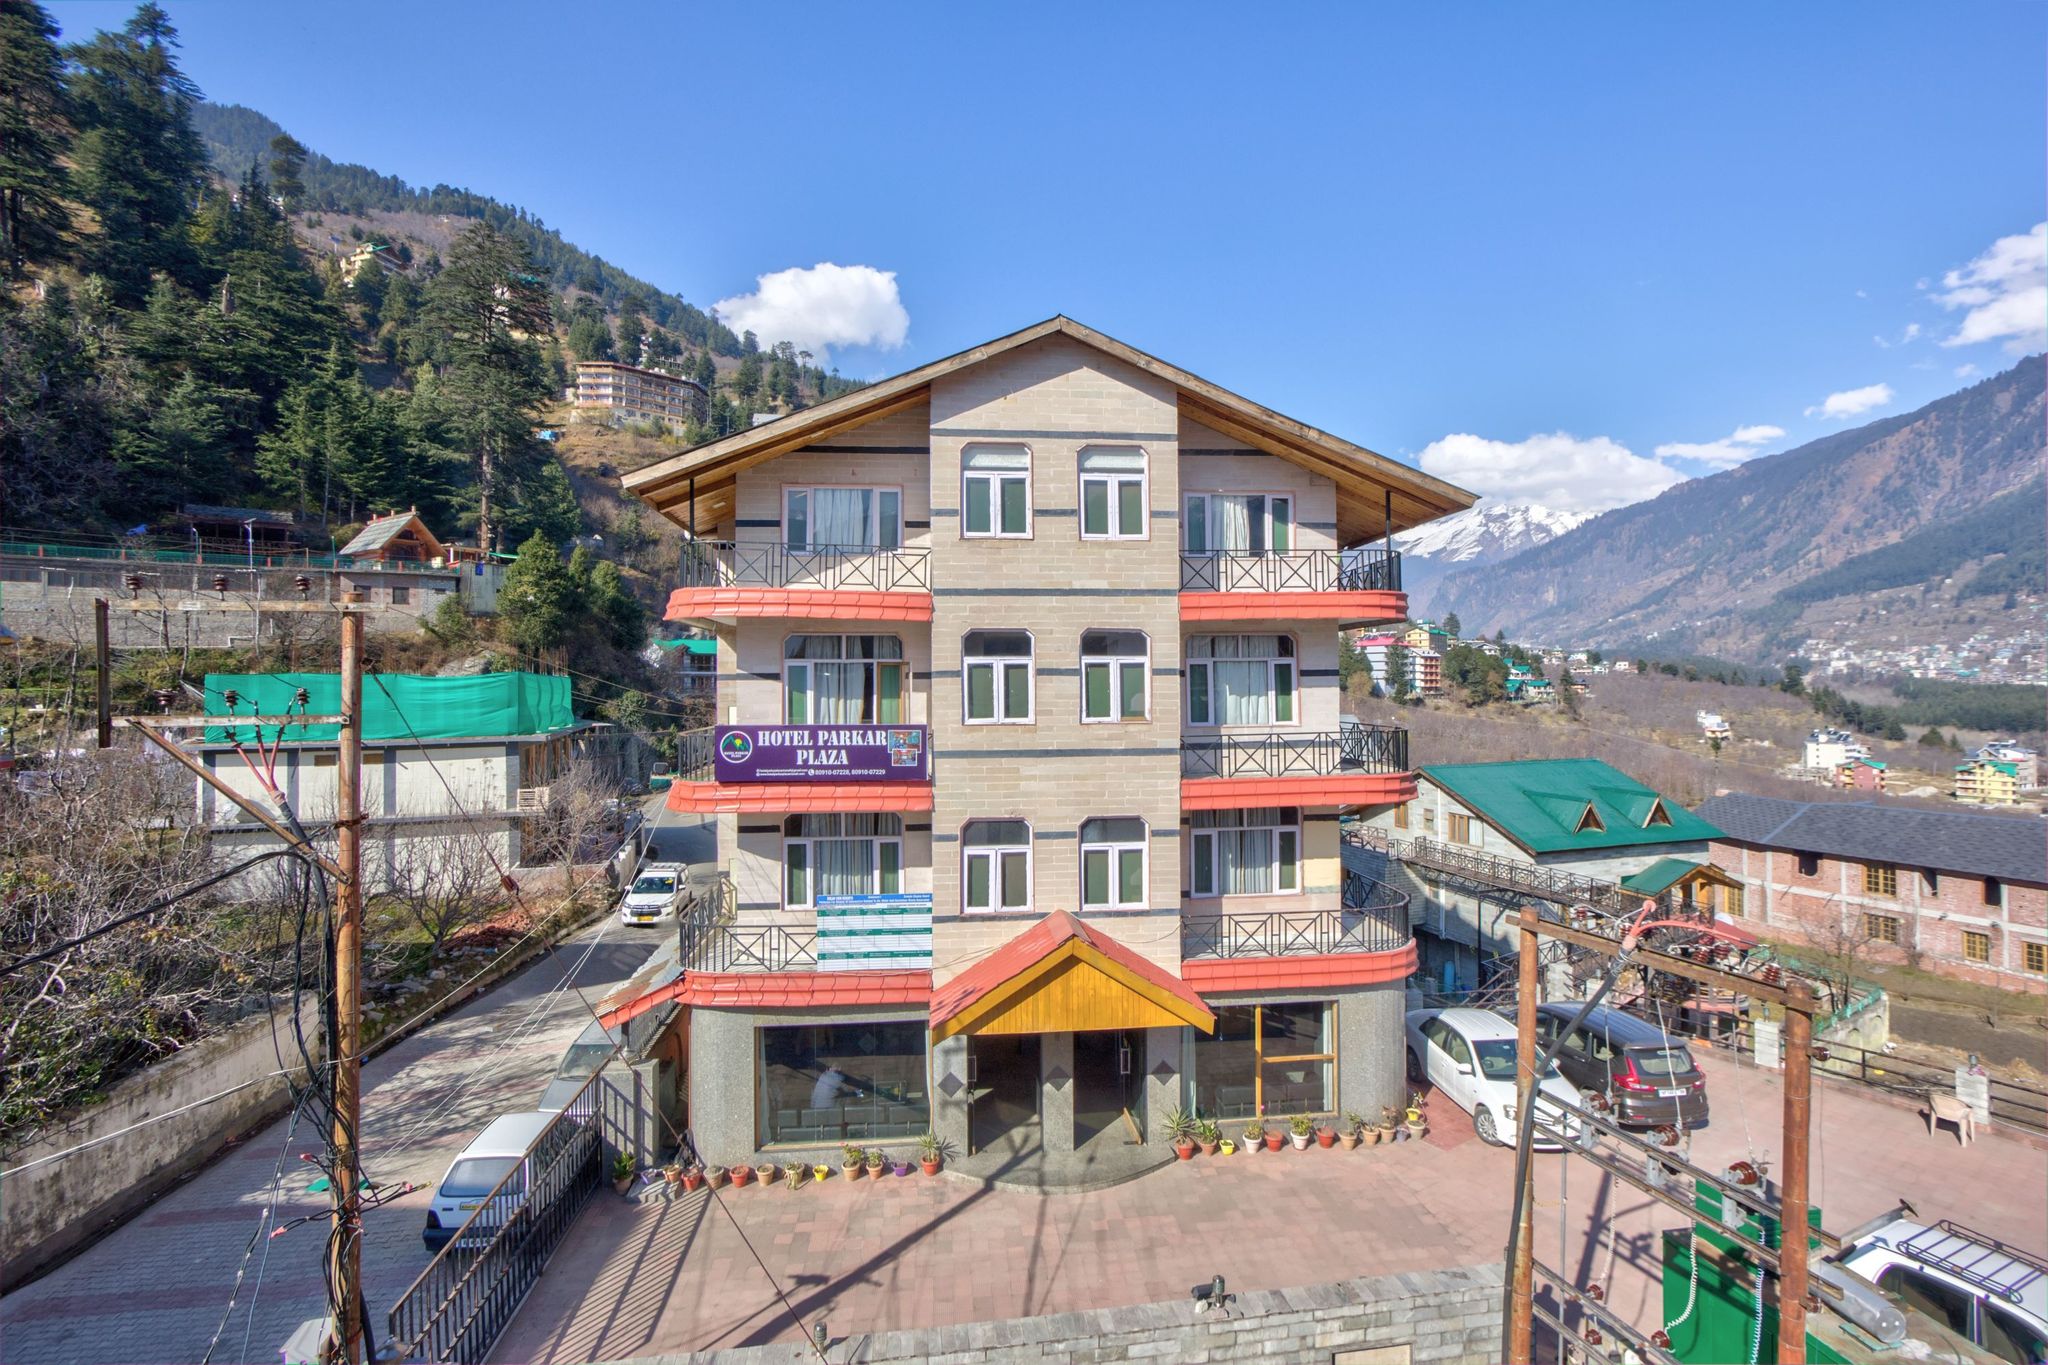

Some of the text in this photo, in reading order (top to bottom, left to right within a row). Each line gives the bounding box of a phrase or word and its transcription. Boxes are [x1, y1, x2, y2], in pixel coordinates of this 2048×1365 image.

[757, 730, 888, 746] HOTEL PARKAR
[796, 749, 849, 765] PLAZA
